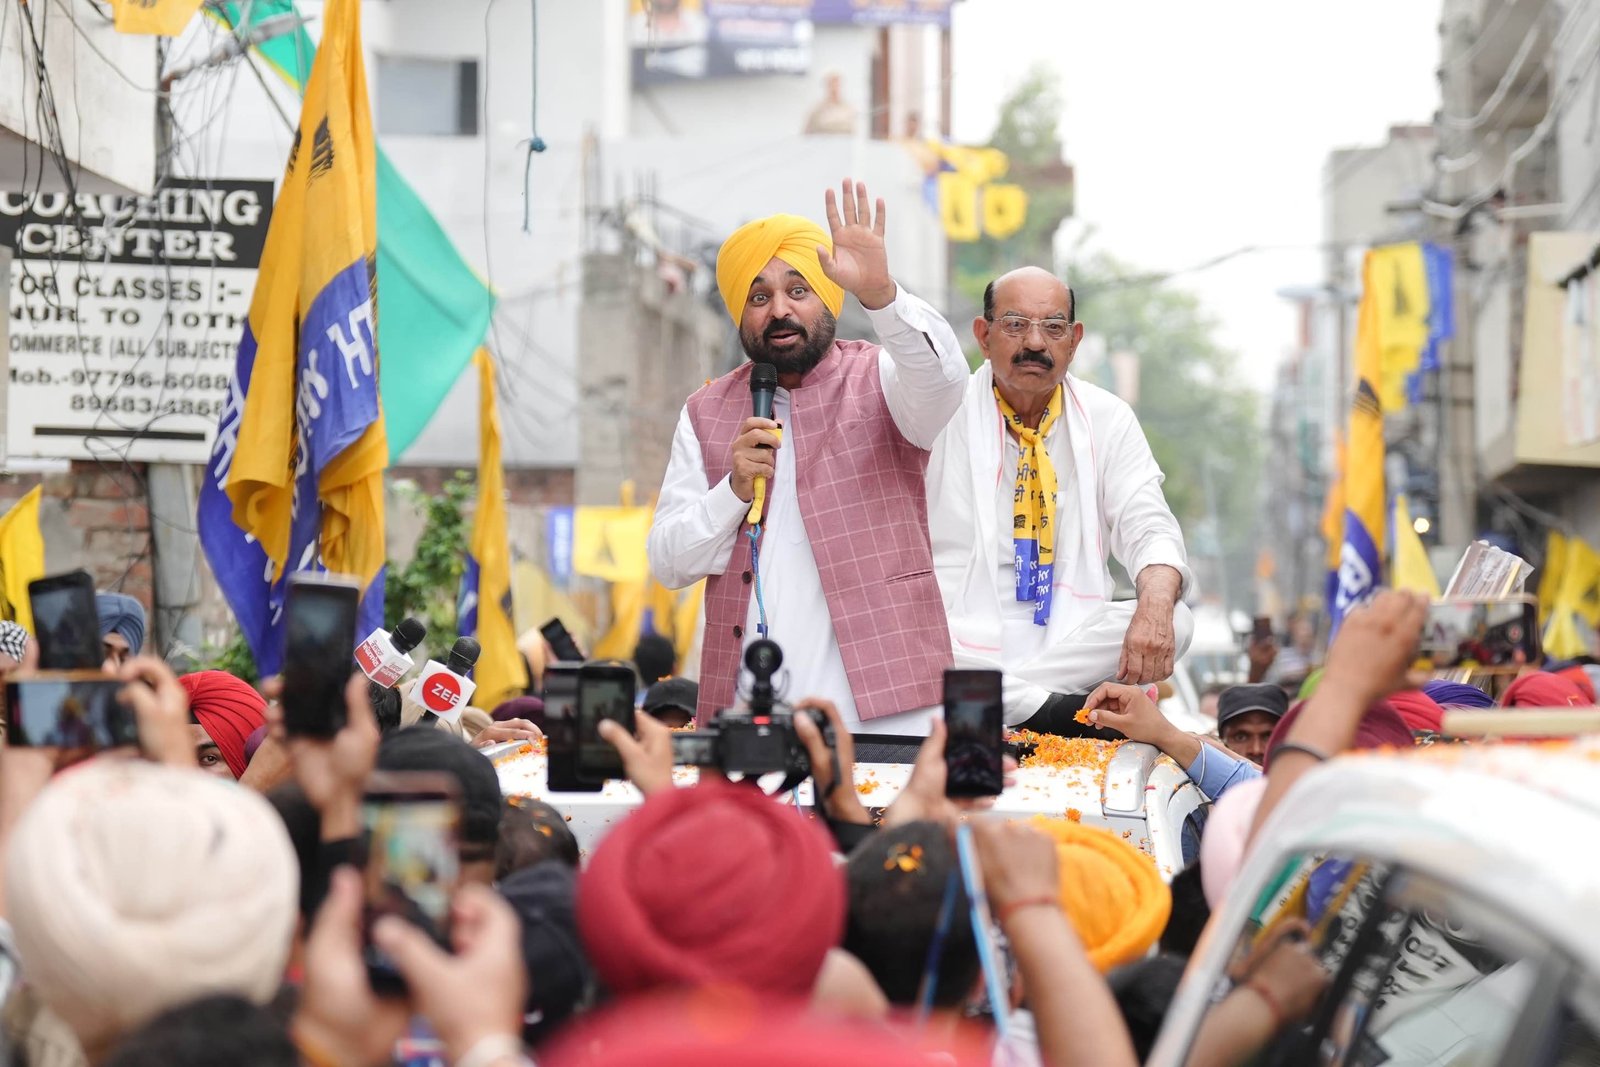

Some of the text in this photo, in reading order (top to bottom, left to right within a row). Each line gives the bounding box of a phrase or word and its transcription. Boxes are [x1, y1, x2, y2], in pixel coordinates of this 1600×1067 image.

[0, 188, 262, 226] COACHING
[16, 223, 238, 261] CENTER
[10, 274, 58, 296] OR
[75, 276, 202, 301] CLASSES
[101, 307, 140, 326] TO
[431, 682, 460, 706] ZEE
